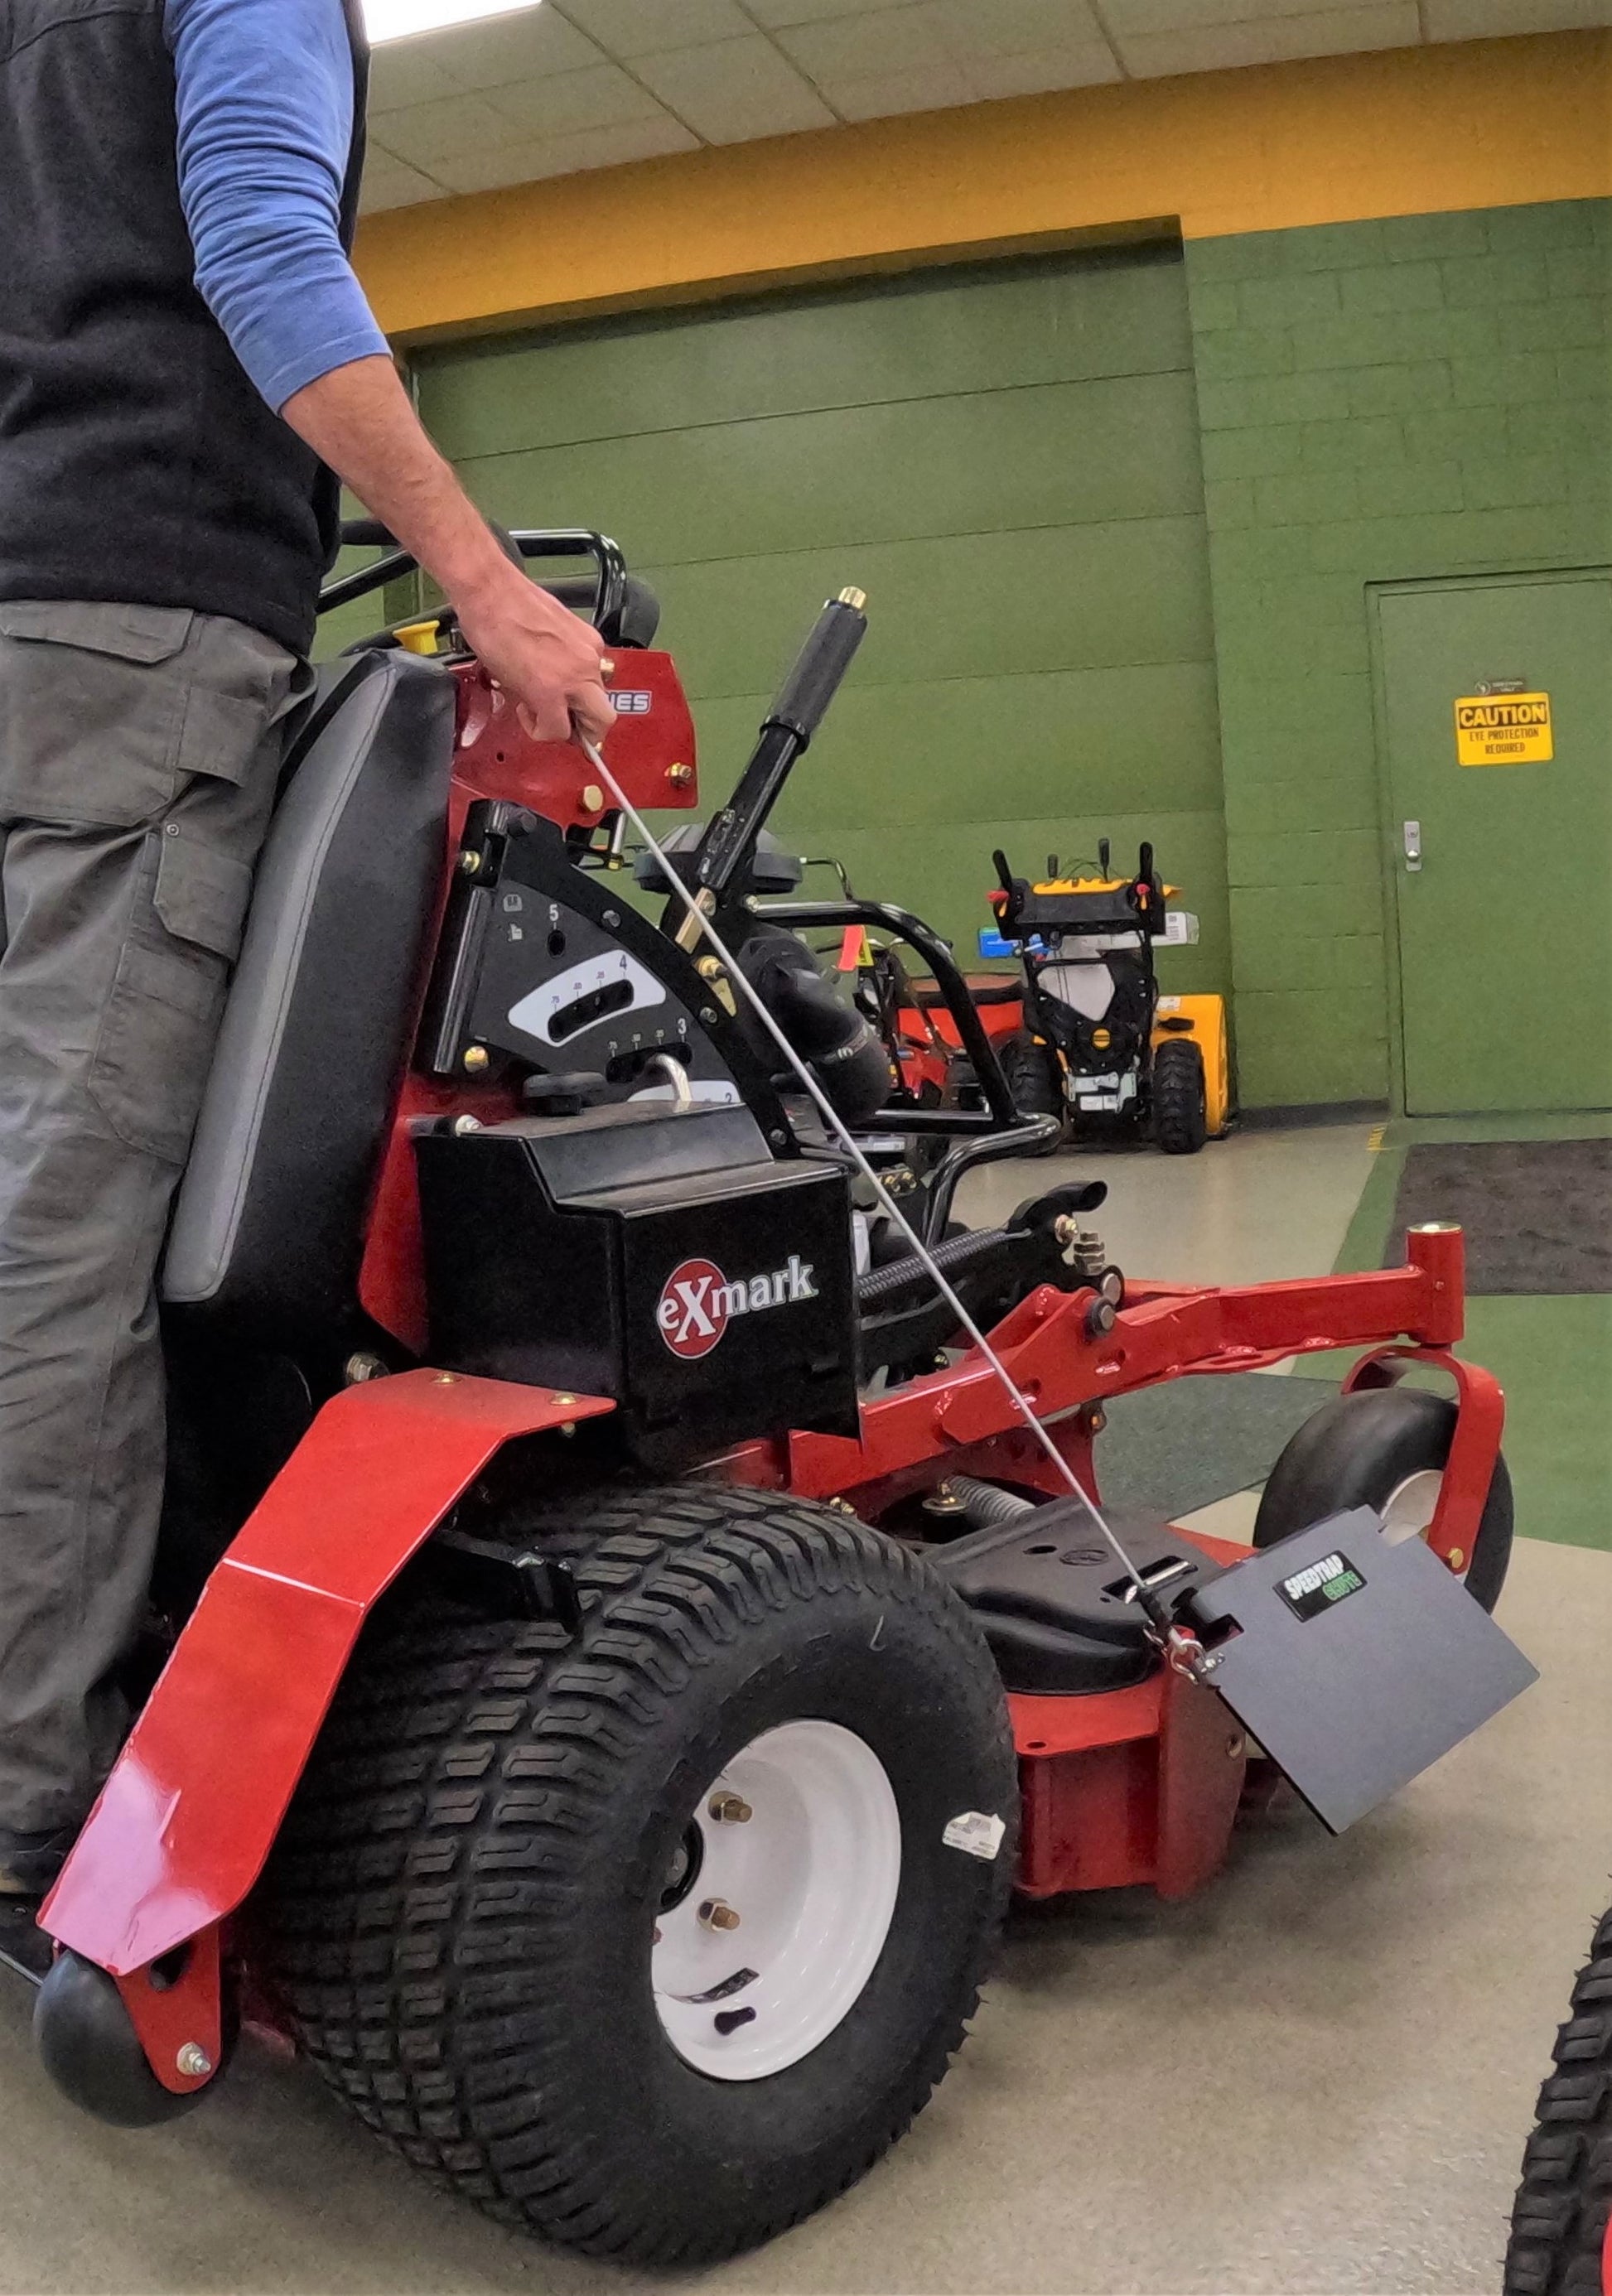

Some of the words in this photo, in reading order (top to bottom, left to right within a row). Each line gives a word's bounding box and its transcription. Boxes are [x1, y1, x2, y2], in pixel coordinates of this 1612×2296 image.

[1460, 703, 1547, 727] CAUTION
[1470, 731, 1485, 742] EYE
[1488, 728, 1539, 741] PROTECTION
[1484, 742, 1526, 755] REQUIRED
[549, 903, 559, 921] 5
[619, 954, 628, 970] 4
[678, 1017, 687, 1035] 3
[1284, 1554, 1344, 1600] SPEEDTRAP
[1322, 1570, 1363, 1601] CHUTE
